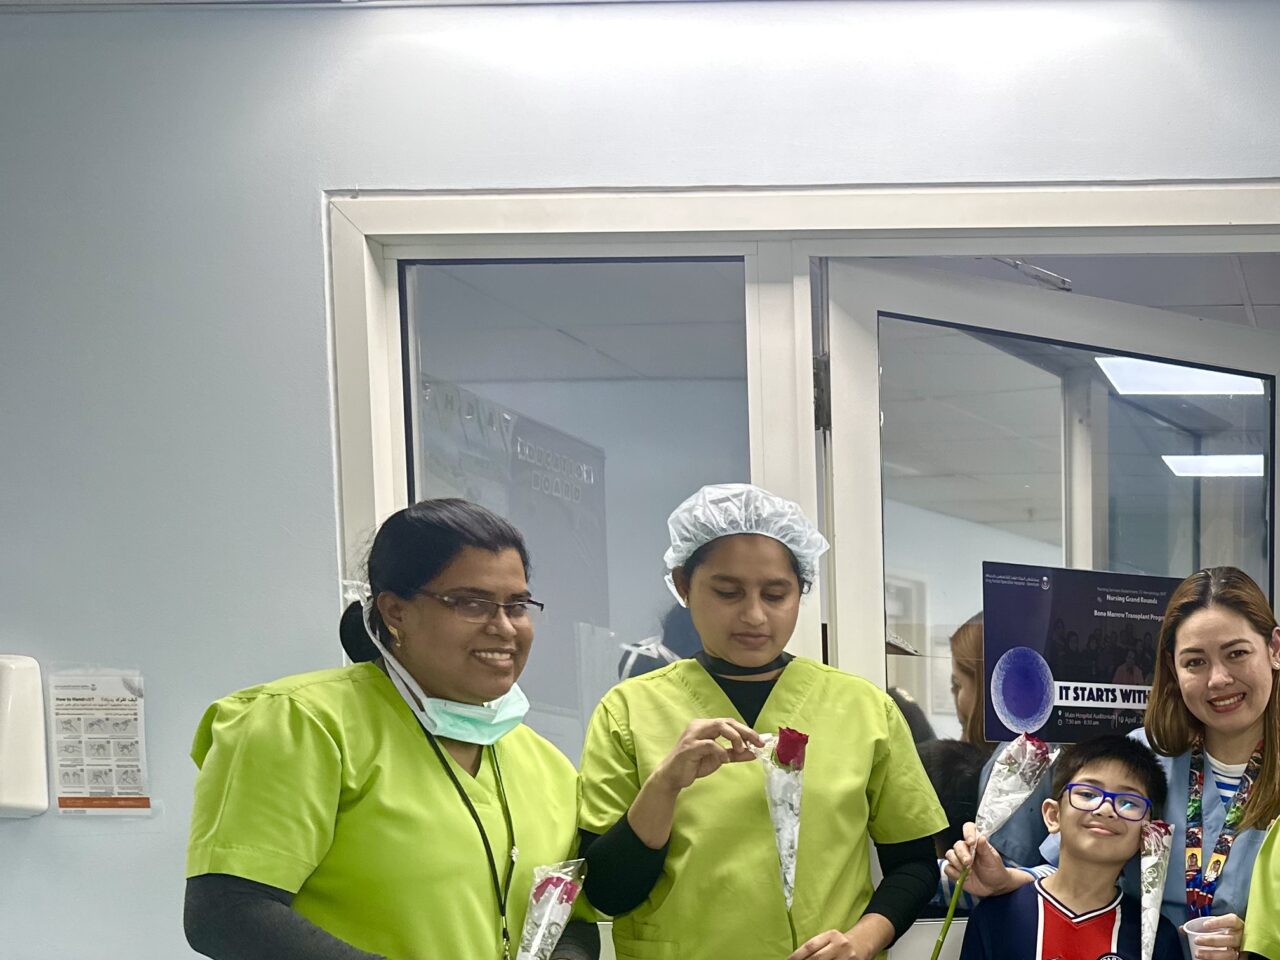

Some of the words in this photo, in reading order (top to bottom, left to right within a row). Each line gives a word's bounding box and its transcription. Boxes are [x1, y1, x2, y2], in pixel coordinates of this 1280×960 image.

[1106, 594, 1125, 603] Nursing
[1125, 595, 1141, 604] Grand
[1140, 596, 1158, 605] Rounds
[1093, 609, 1107, 617] Bone
[1106, 610, 1125, 619] Marrow
[1125, 612, 1150, 621] Transplant
[1058, 685, 1071, 701] IT
[1072, 686, 1118, 703] STARTS
